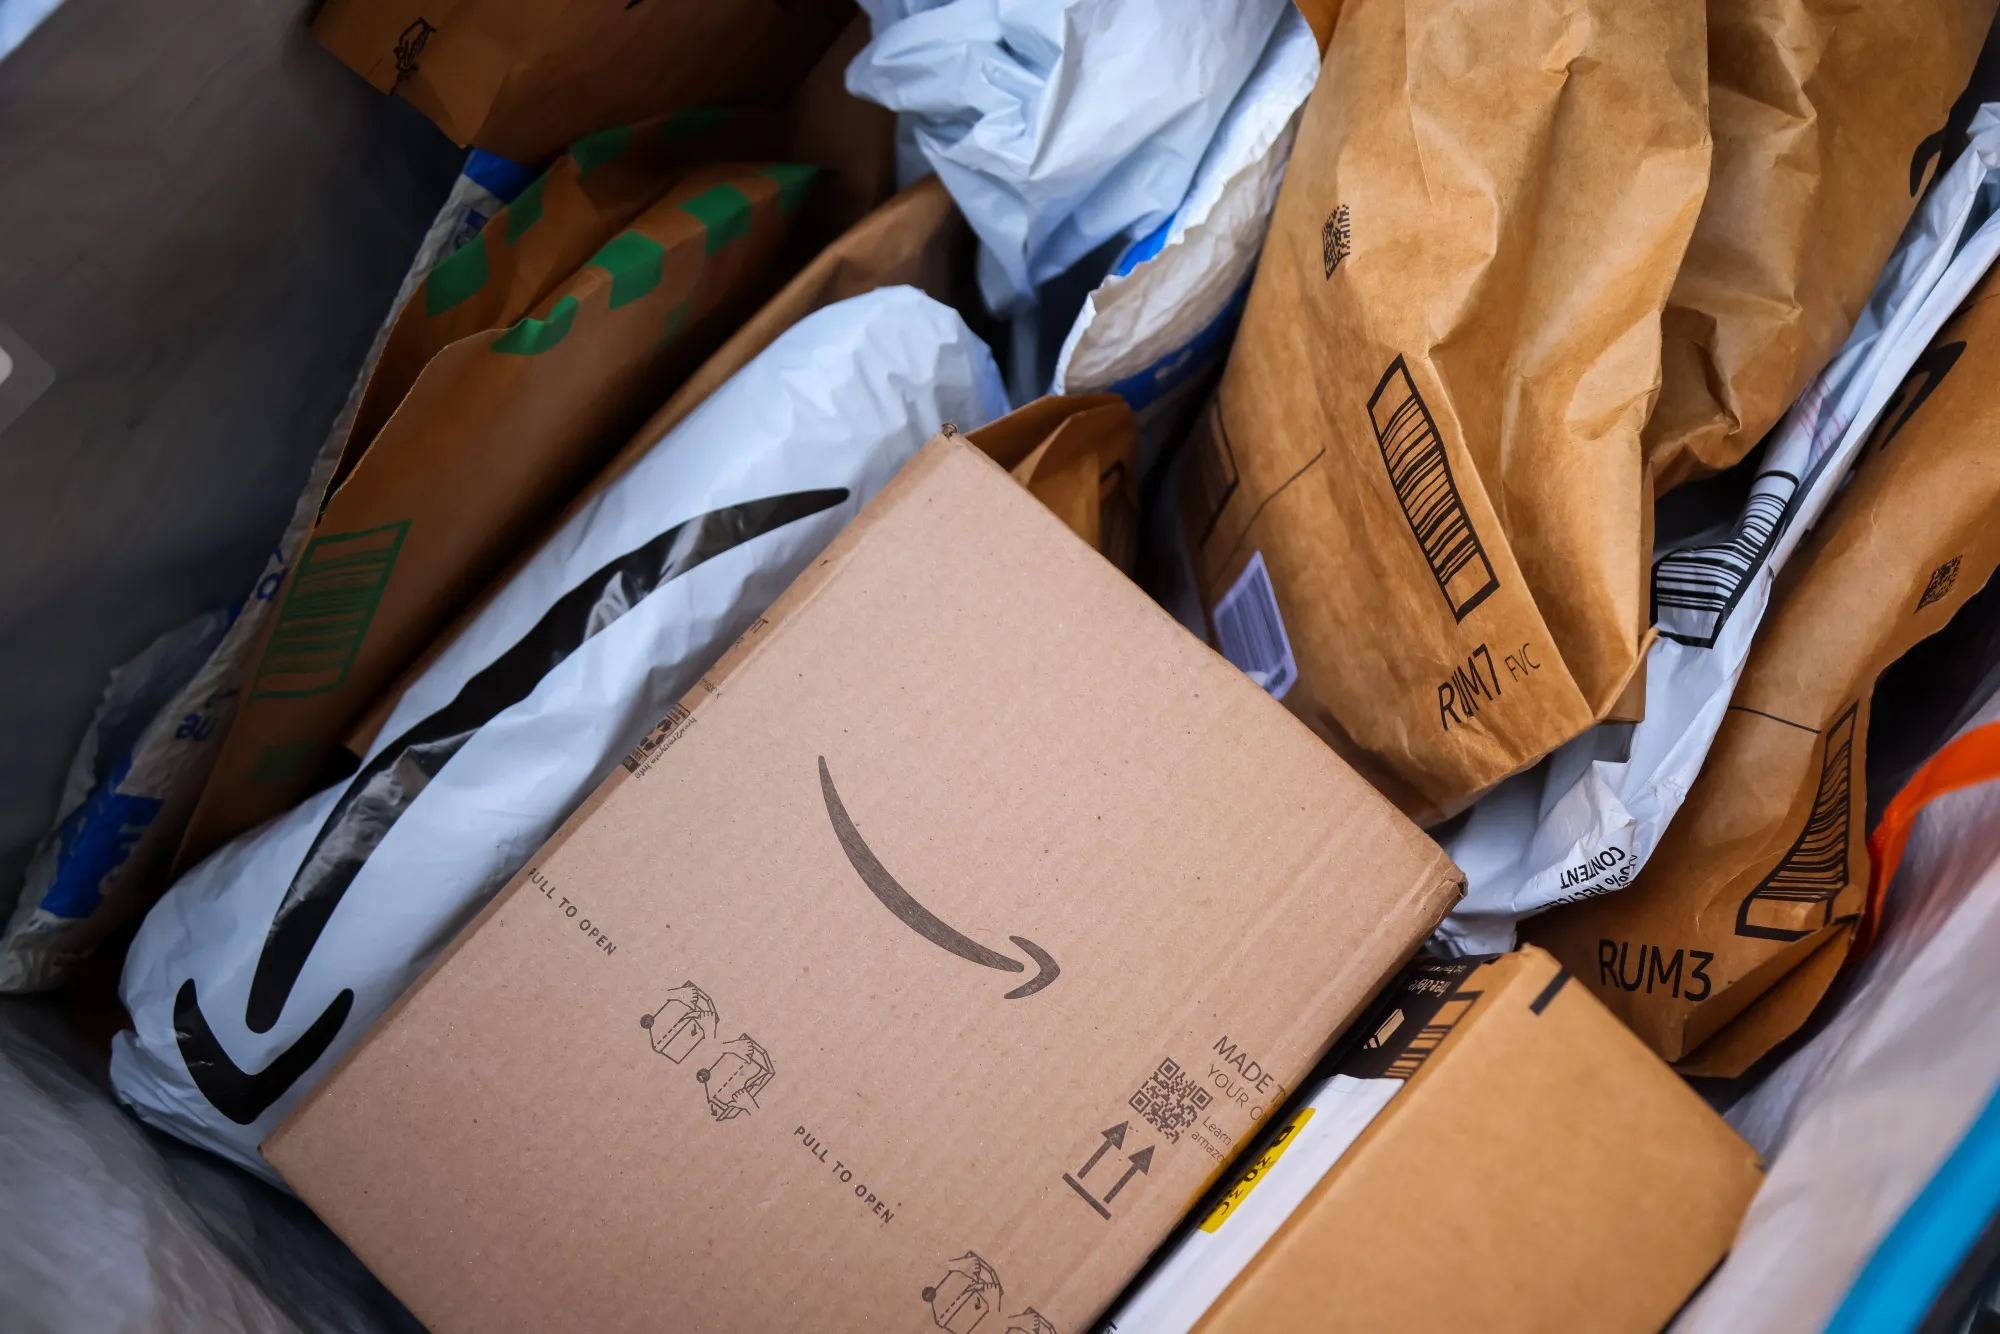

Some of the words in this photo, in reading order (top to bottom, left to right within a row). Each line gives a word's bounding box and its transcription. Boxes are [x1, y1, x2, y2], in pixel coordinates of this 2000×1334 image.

[1438, 643, 1501, 731] RUM7
[1505, 642, 1541, 682] FVC
[1560, 846, 1626, 890] CONTENT
[528, 867, 556, 900] PULL
[558, 896, 578, 918] TO
[579, 918, 617, 956] OPEN
[1598, 938, 1714, 1002] RUM3
[1207, 1063, 1250, 1109] YOUR
[1212, 1035, 1275, 1095] MADE
[1202, 1115, 1233, 1147] Learn
[793, 1125, 829, 1164] PULL
[832, 1160, 853, 1183] TO
[854, 1184, 895, 1224] OPEN
